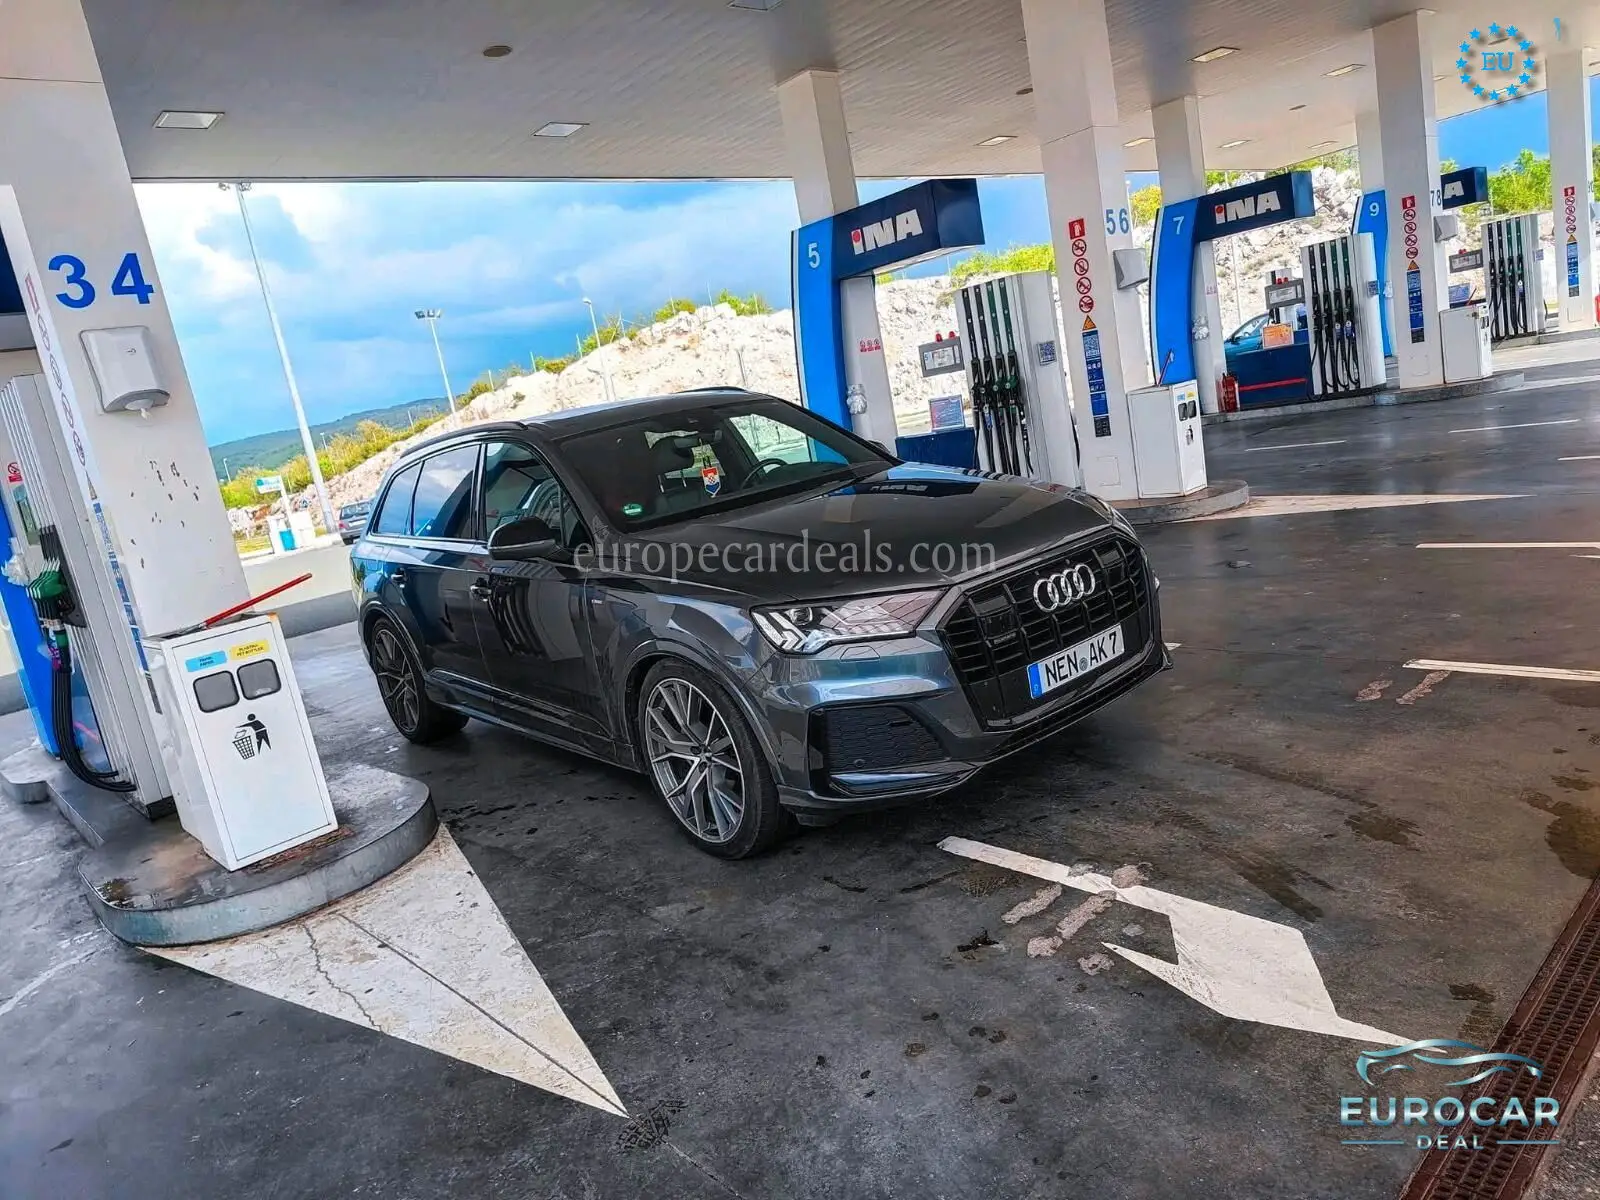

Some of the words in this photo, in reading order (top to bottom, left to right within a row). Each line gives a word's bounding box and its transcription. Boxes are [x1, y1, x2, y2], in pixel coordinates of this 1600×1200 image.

[1370, 202, 1380, 217] 9
[1173, 216, 1185, 235] 7
[808, 242, 821, 269] 5
[1045, 650, 1080, 687] NEN
[1089, 636, 1108, 667] AK
[1109, 631, 1117, 655] 7
